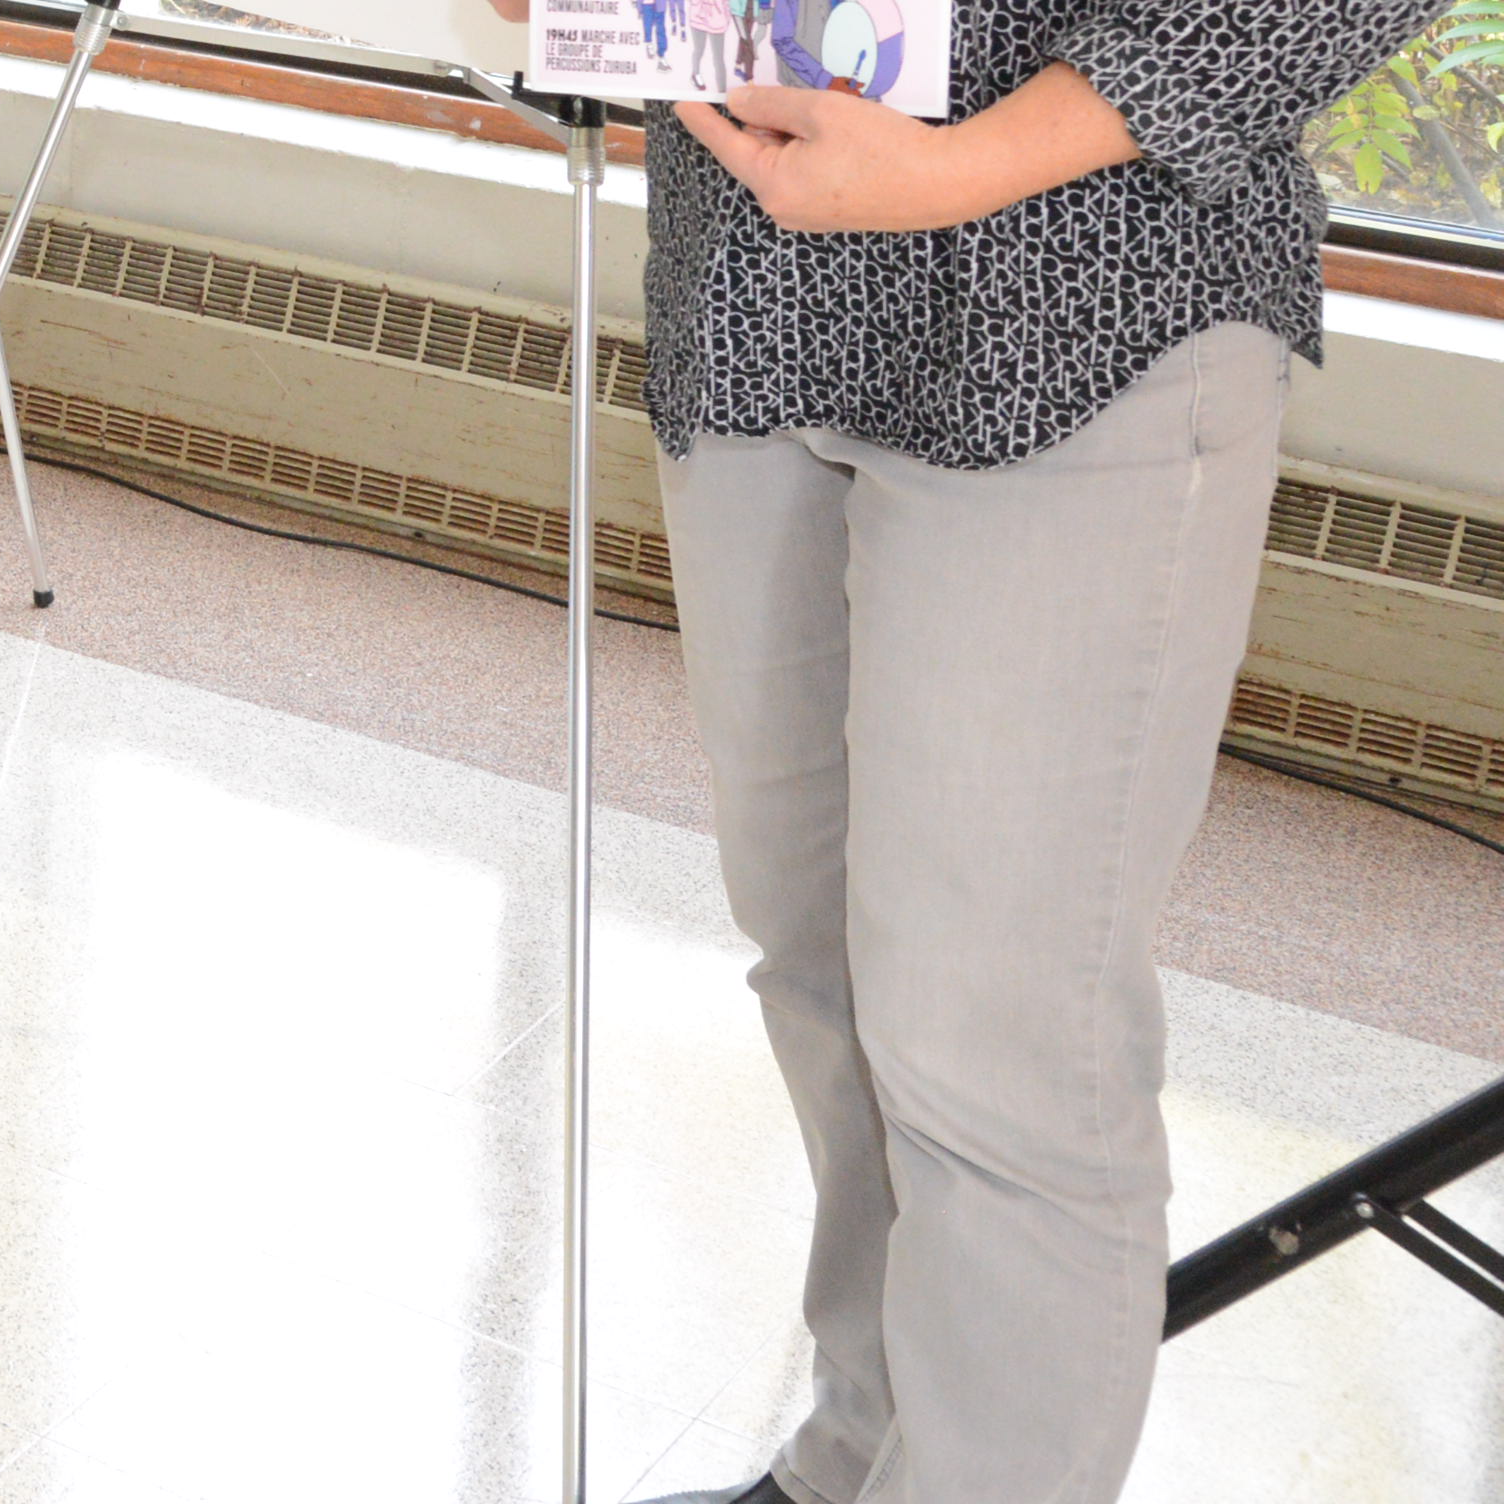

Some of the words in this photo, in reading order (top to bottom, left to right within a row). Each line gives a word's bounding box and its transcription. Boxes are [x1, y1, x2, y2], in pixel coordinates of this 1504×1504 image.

[546, 0, 620, 16] COMMUNAUTAIRE
[546, 28, 578, 42] 19H45
[581, 29, 617, 45] MARCHE
[619, 31, 641, 45] AVEC
[545, 42, 555, 57] LE
[557, 43, 590, 58] GROUPE
[591, 44, 604, 58] DE
[545, 57, 601, 73] PERCUSSIONS
